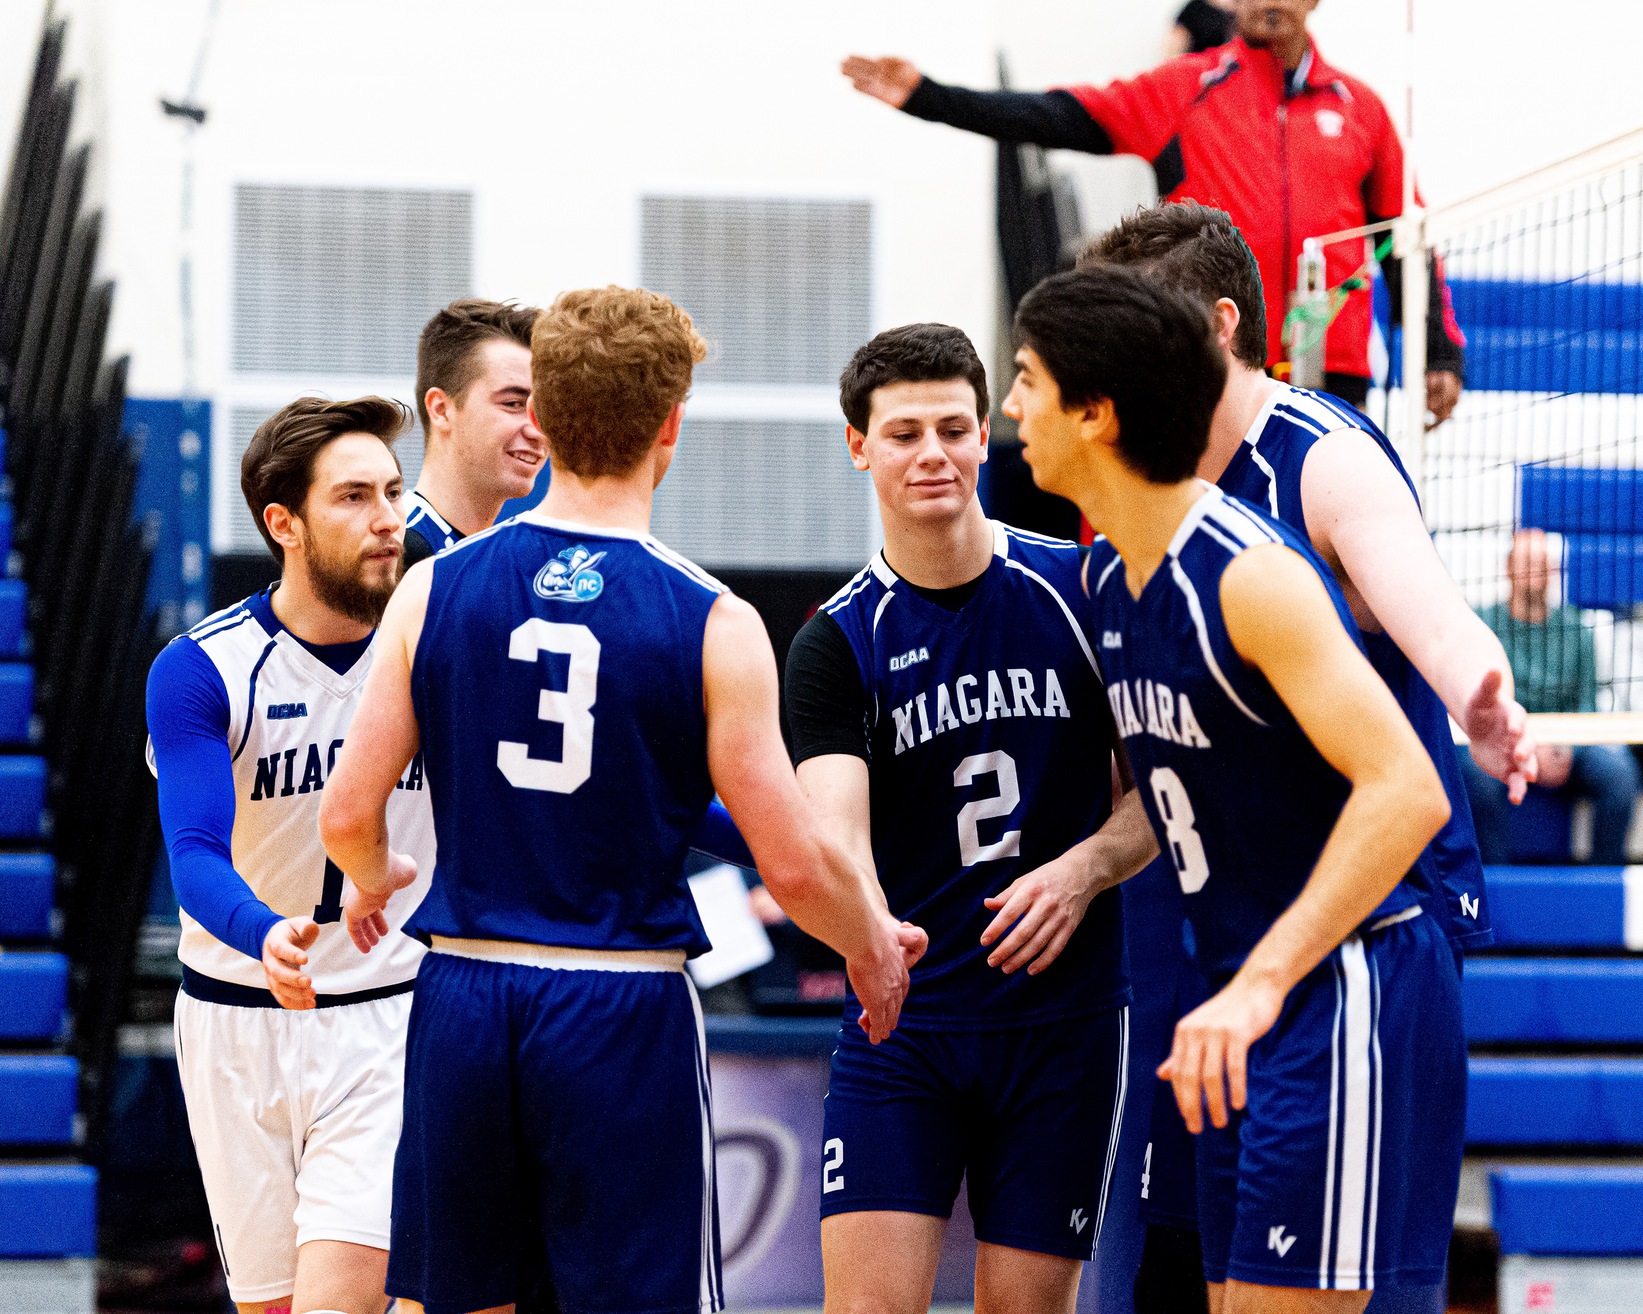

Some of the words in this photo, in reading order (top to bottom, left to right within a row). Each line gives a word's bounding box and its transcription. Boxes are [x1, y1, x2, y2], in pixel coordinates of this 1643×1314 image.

[889, 646, 930, 672] OCAA
[496, 617, 601, 794] 3
[892, 668, 1071, 756] NIAGARA
[250, 738, 424, 801] NIAA
[953, 749, 1021, 867] 2
[1149, 766, 1210, 895] 8
[823, 1137, 845, 1195] 2
